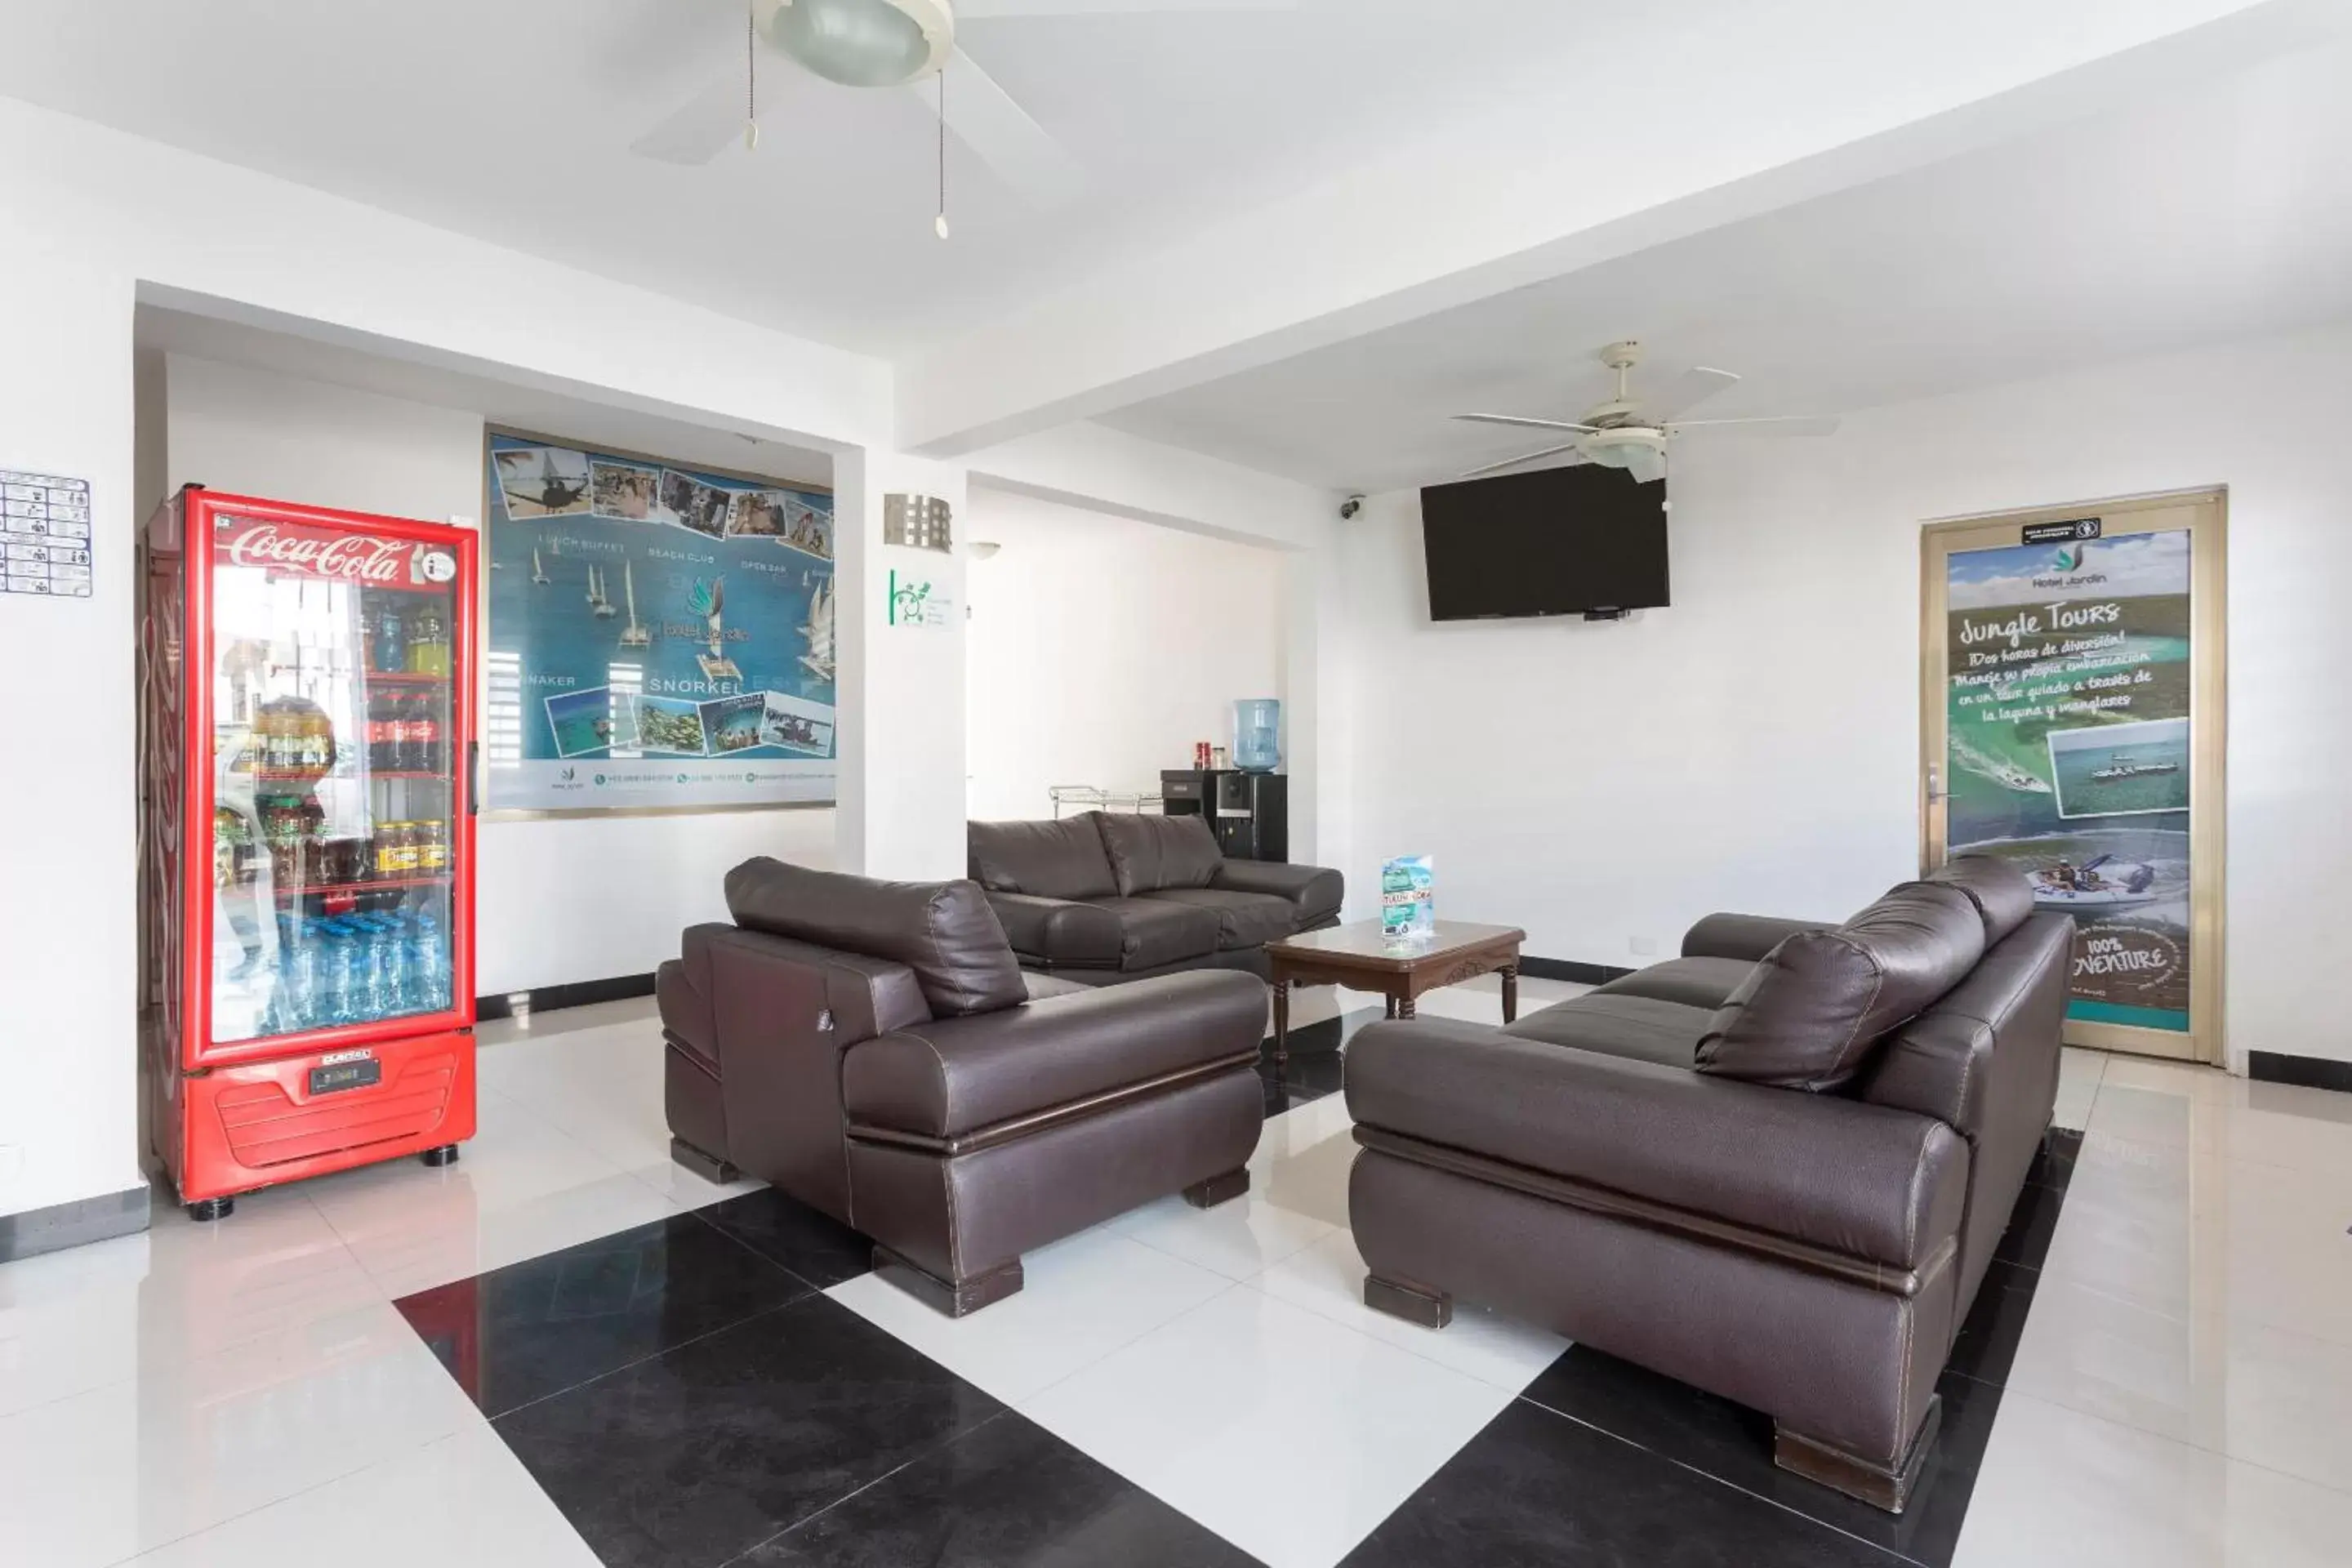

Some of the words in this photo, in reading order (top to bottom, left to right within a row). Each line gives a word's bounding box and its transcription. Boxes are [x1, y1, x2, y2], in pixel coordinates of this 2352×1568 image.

[229, 525, 411, 581] Coca-Cola
[1960, 612, 2042, 648] Jungle
[2042, 642, 2059, 657] de
[649, 678, 742, 696] SNORKEL
[1958, 696, 1973, 706] en
[1976, 693, 1993, 703] un
[2027, 681, 2069, 702] guiado
[2074, 681, 2086, 691] a
[2134, 669, 2154, 684] de
[1982, 709, 1995, 722] la
[1998, 707, 2042, 724] laguna
[2046, 705, 2056, 721] y
